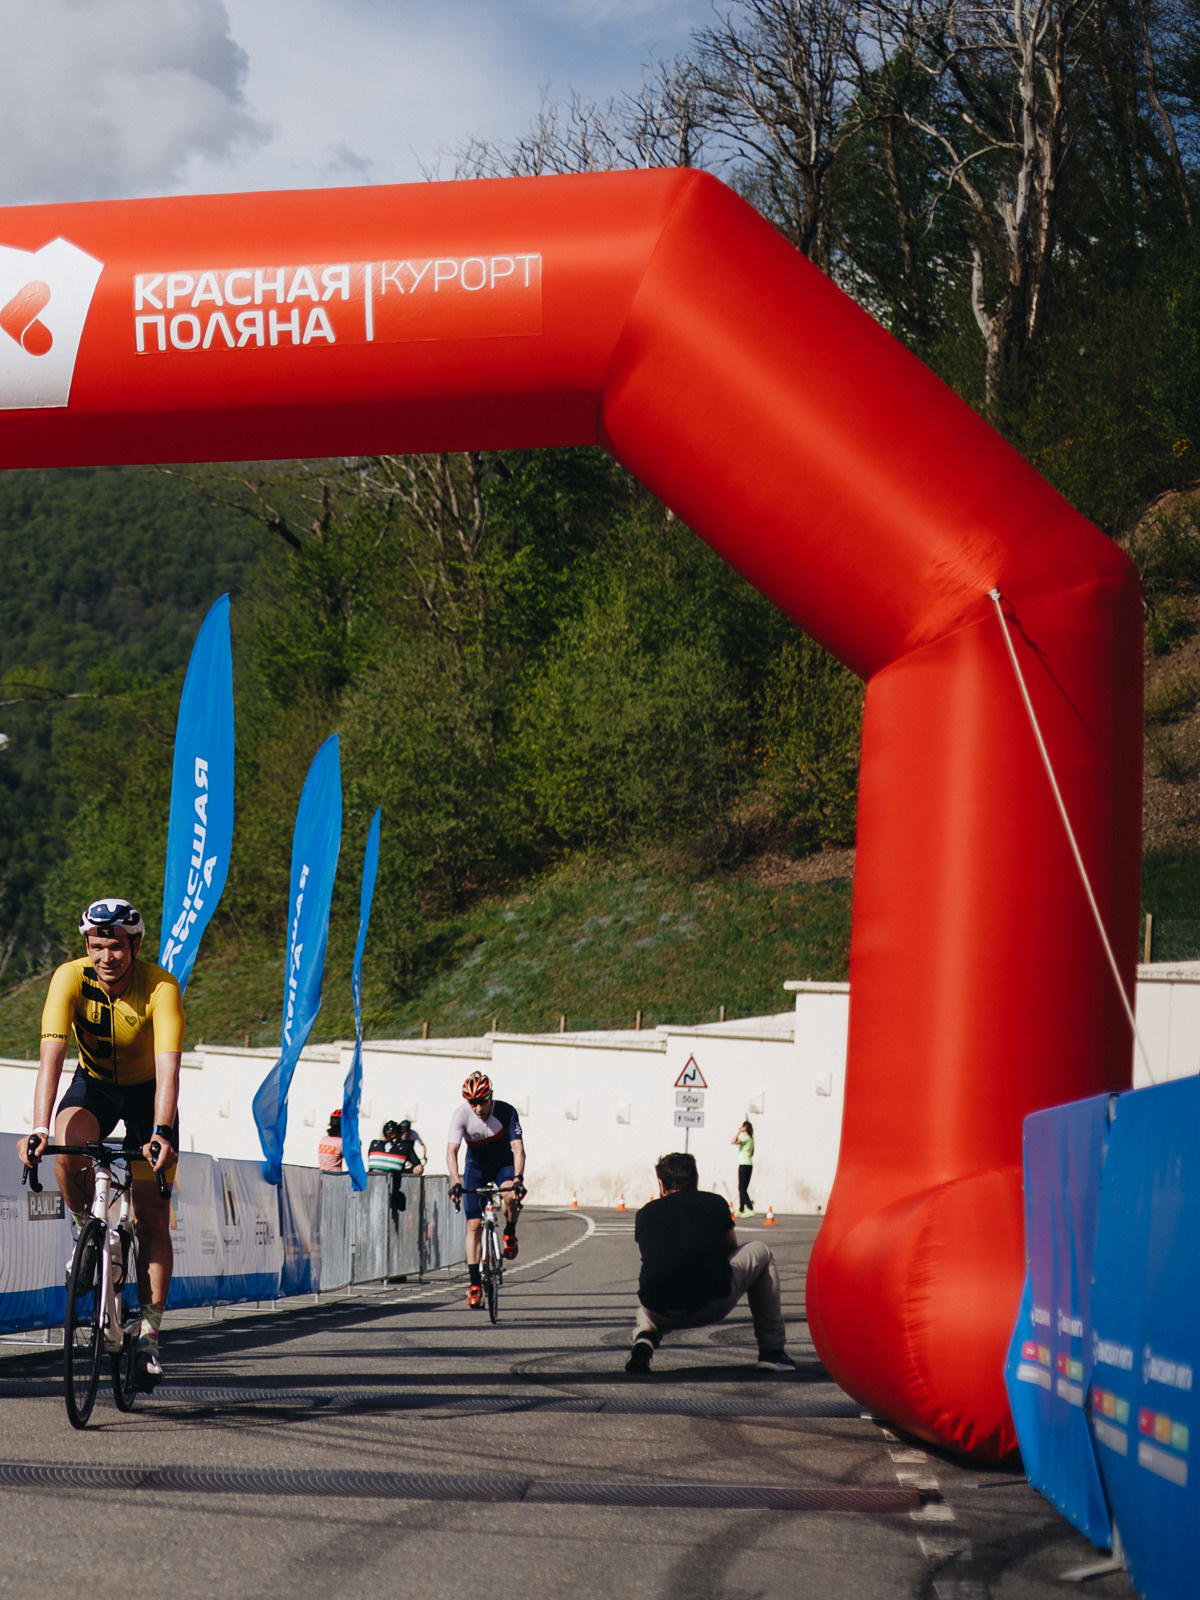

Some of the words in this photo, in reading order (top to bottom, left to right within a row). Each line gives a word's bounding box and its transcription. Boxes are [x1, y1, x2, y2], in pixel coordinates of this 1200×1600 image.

[135, 265, 349, 311] КРАСНАЯ
[382, 255, 539, 295] КУРОРТ
[136, 307, 335, 352] ПОЛЯНА
[161, 757, 208, 967] ВЫСШАЯ
